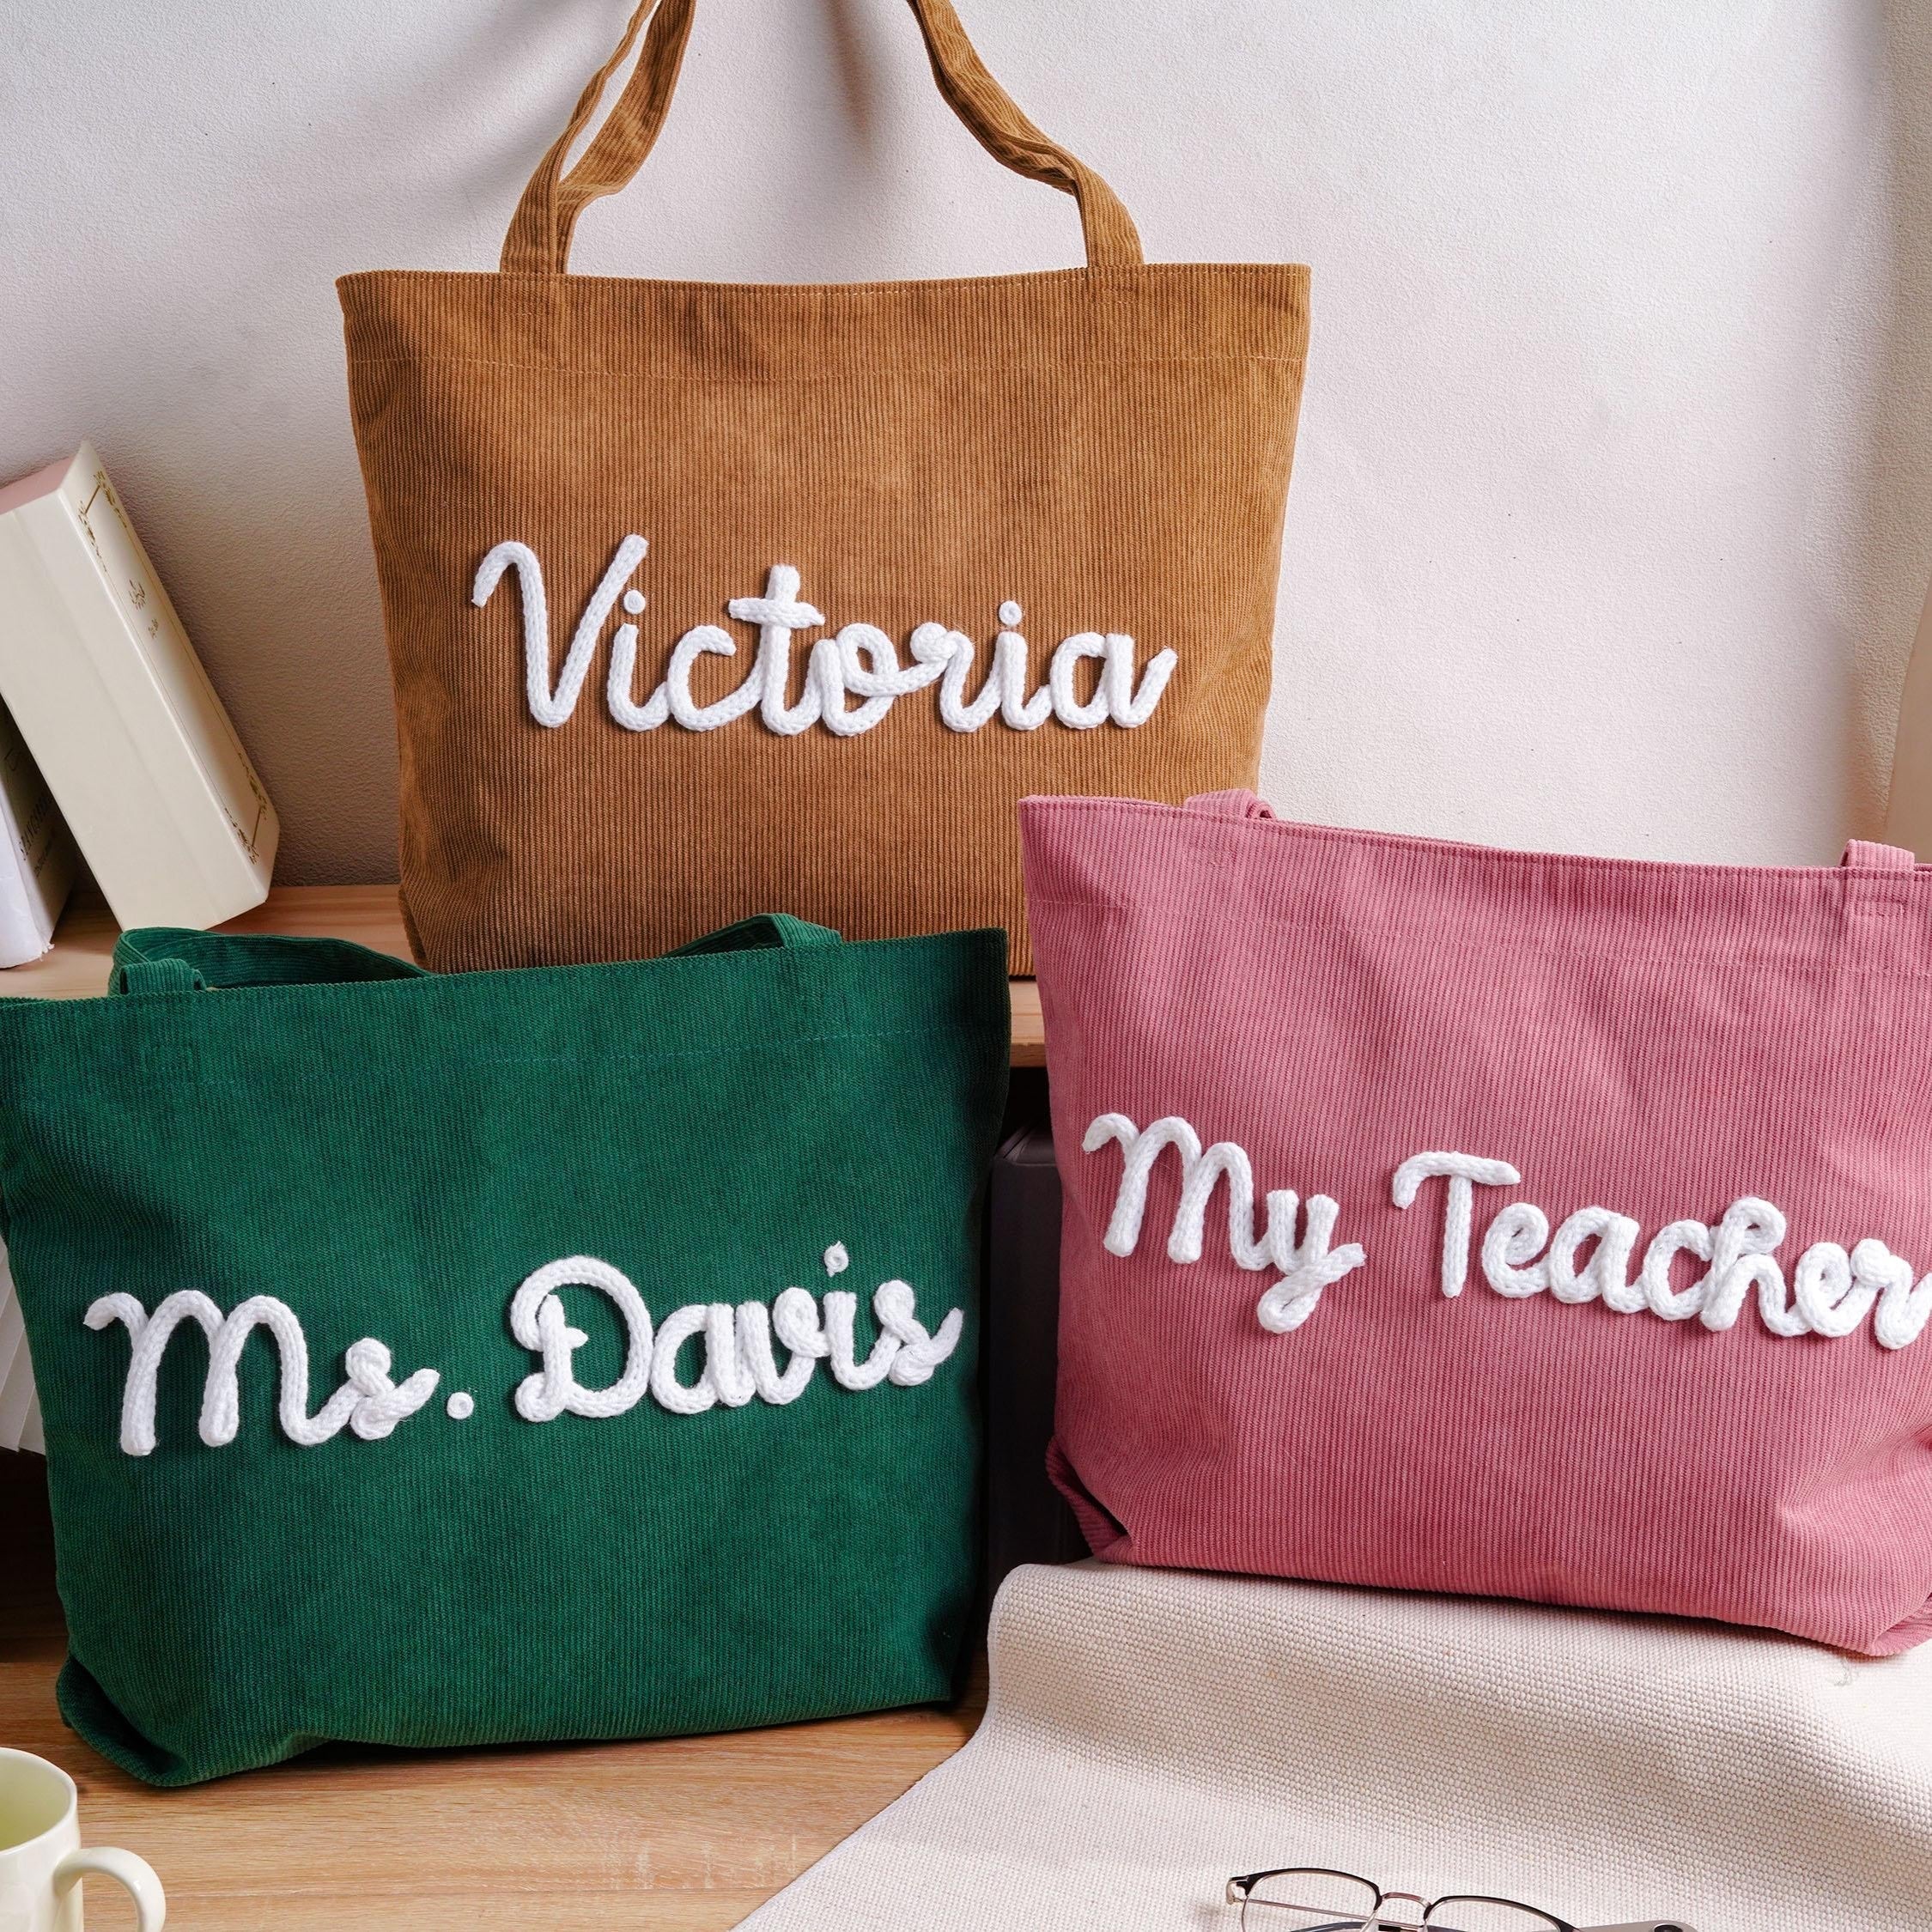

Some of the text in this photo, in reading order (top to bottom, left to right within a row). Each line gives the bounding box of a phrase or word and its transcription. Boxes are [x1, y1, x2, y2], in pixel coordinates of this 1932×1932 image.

[471, 533, 1179, 737] Victoria
[1082, 1113, 1932, 1351] My Teacher
[83, 1241, 963, 1456] Ms. Davis
